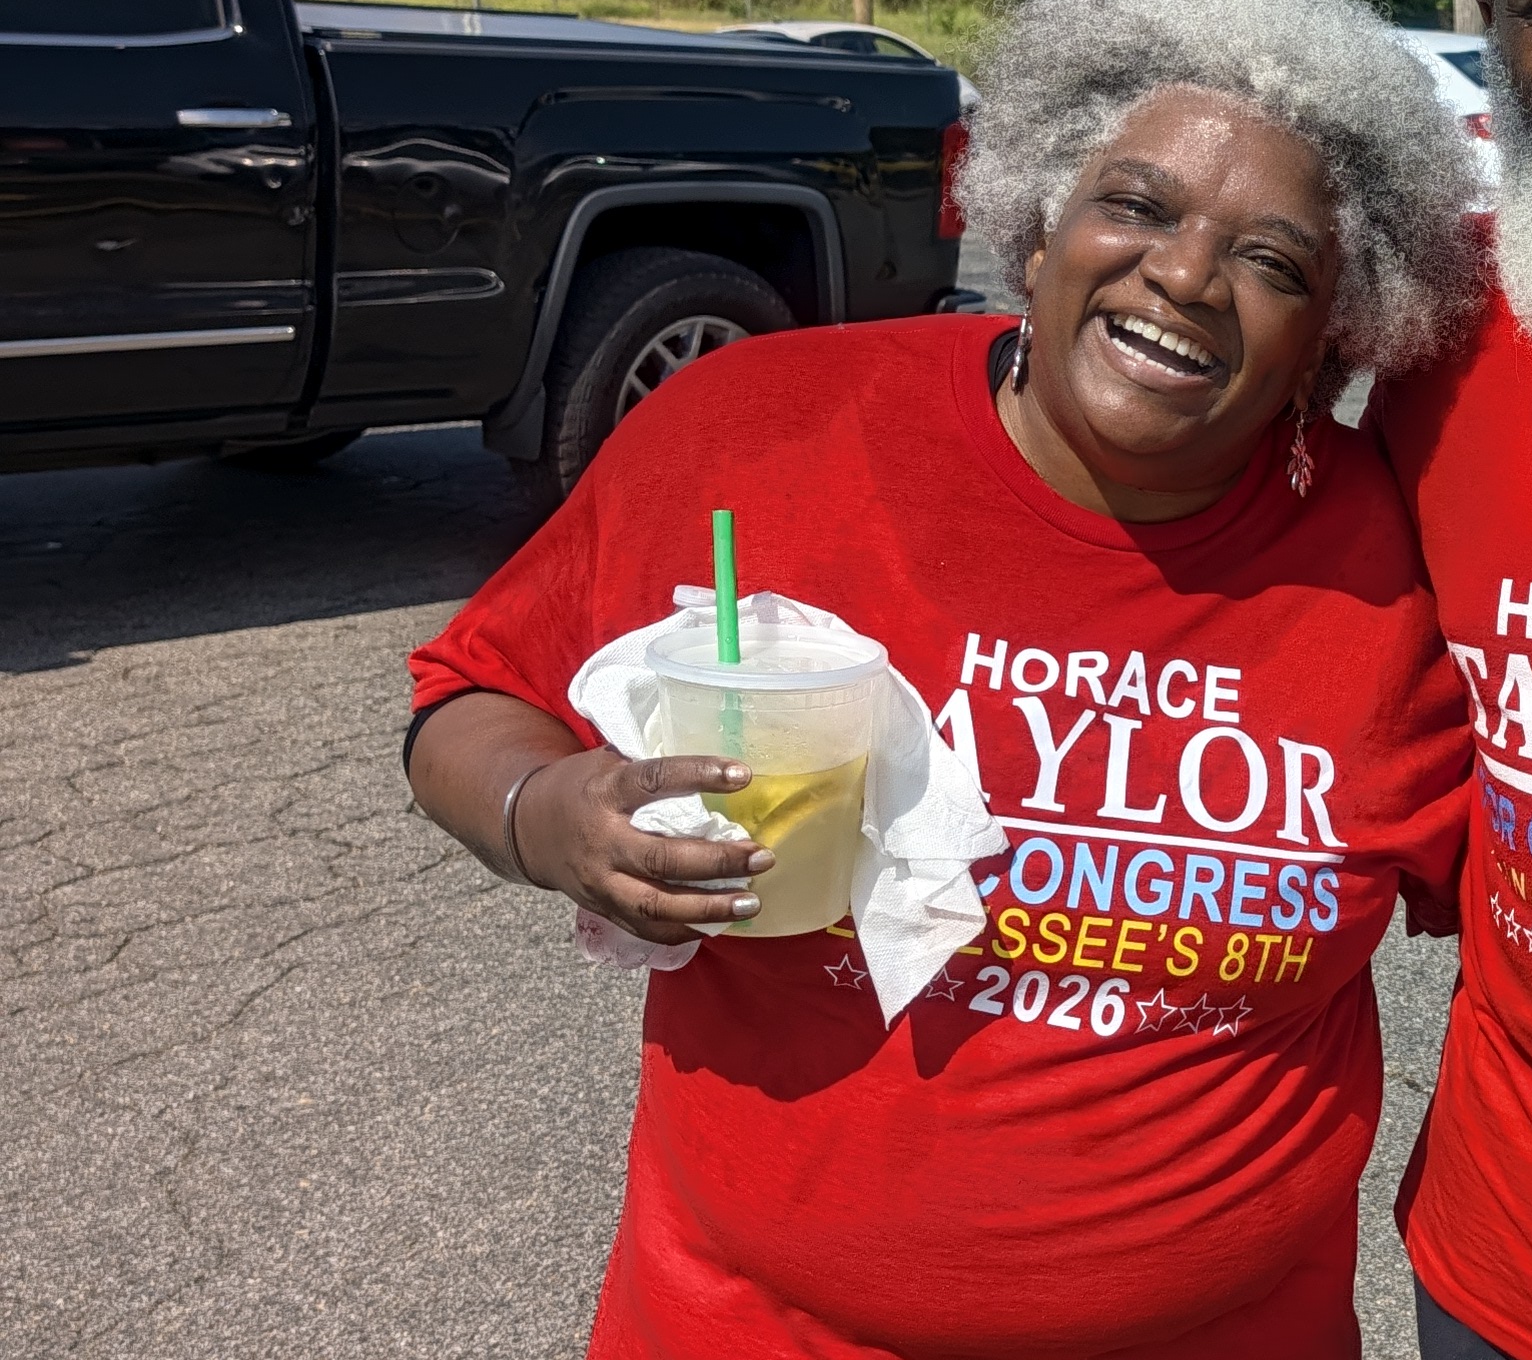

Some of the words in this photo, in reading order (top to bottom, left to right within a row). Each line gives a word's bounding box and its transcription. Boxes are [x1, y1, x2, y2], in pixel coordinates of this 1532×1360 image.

[960, 632, 1242, 723] HORACE
[1218, 932, 1314, 983] 8TH
[968, 965, 1131, 1037] 2026
